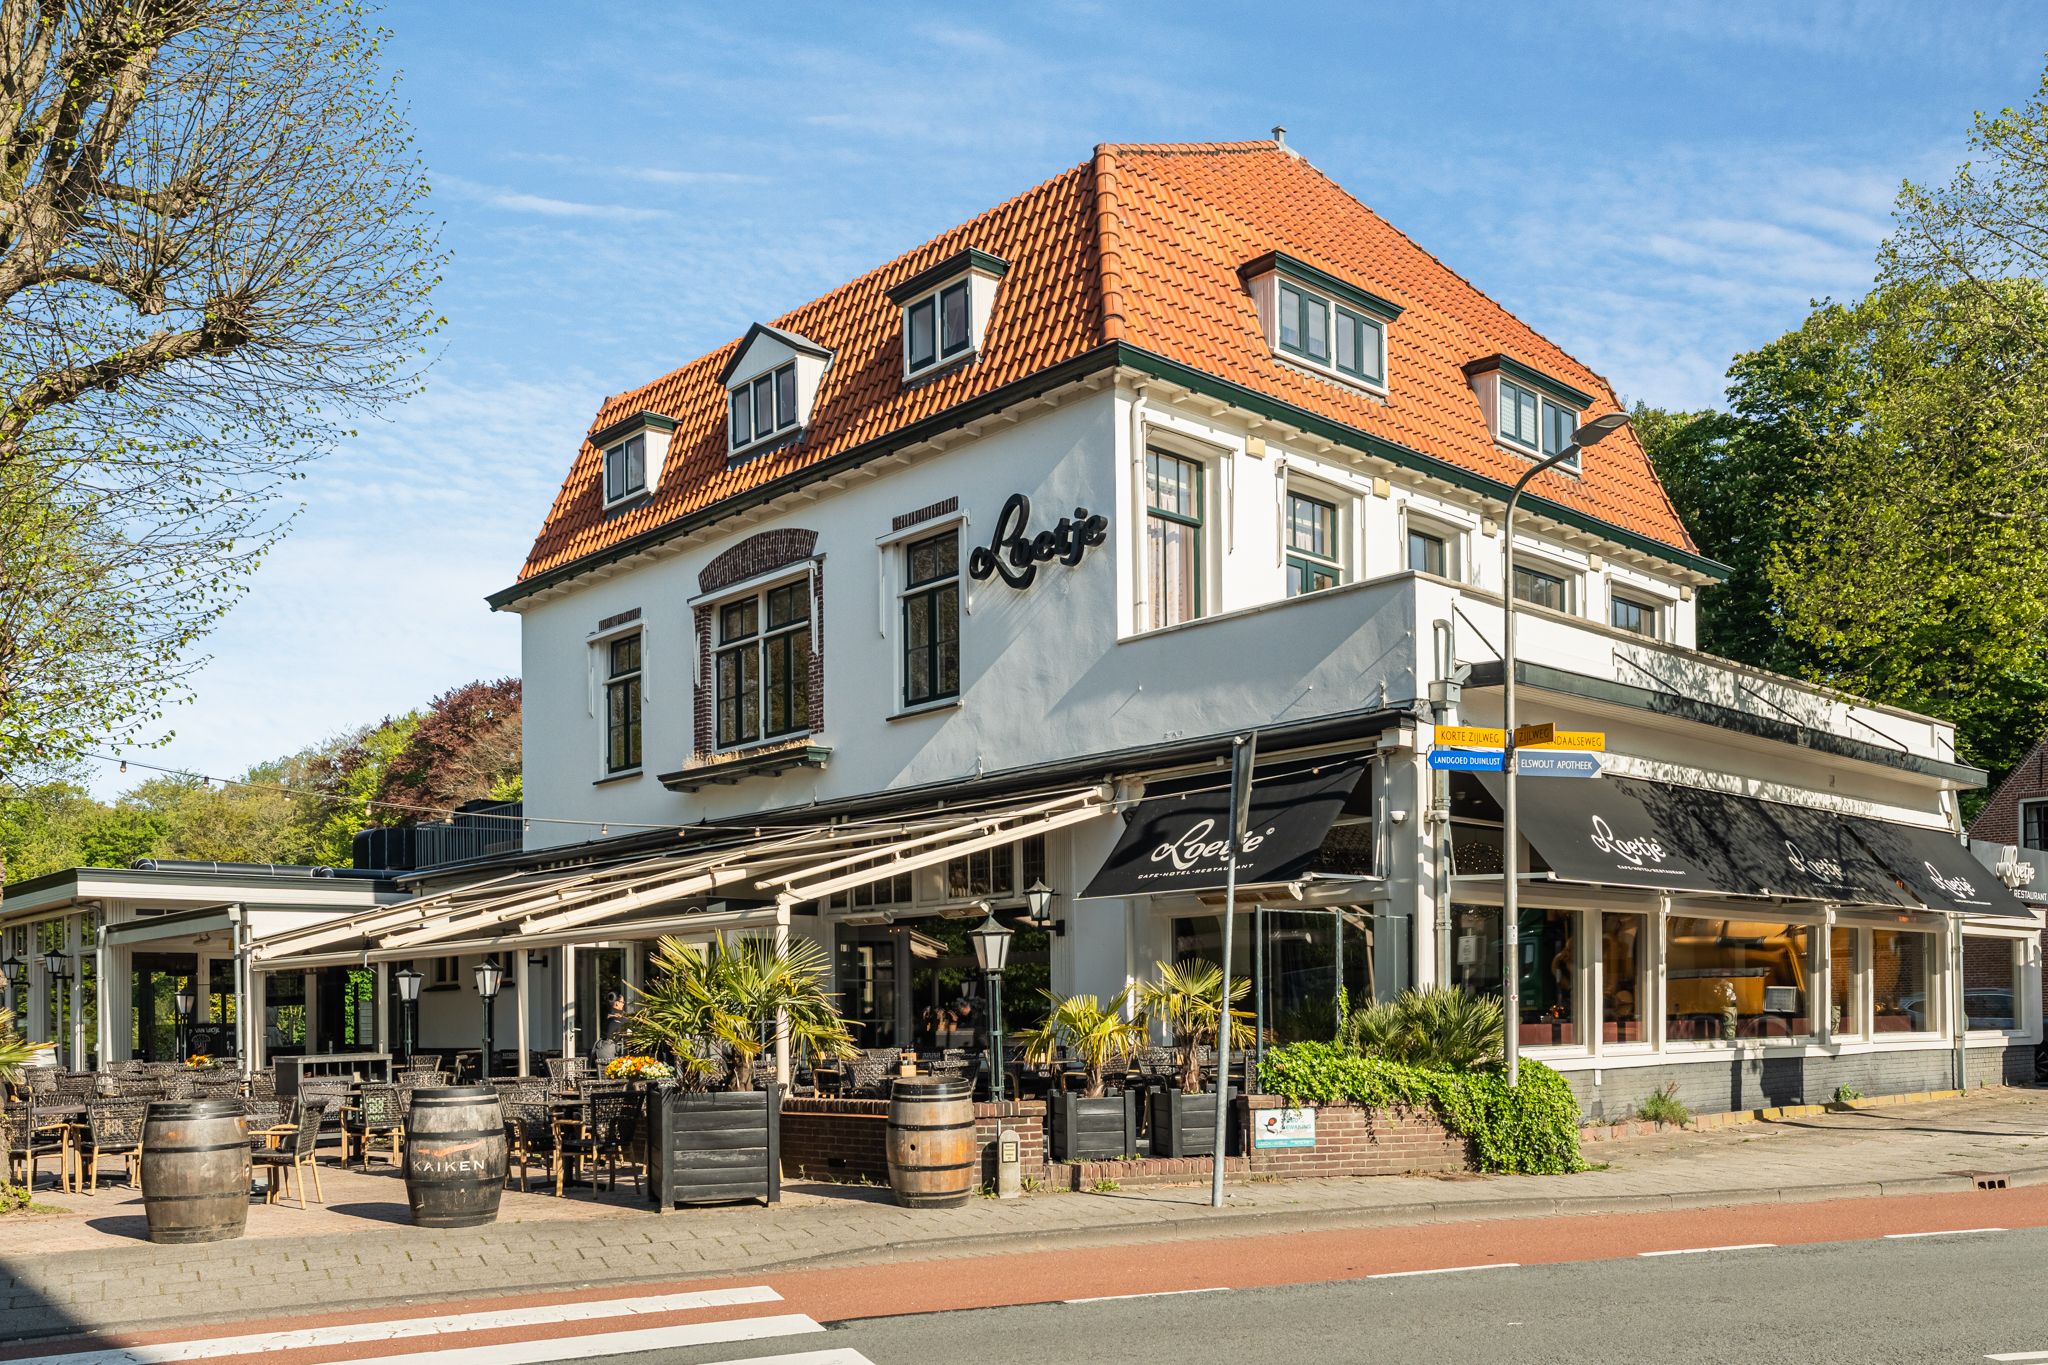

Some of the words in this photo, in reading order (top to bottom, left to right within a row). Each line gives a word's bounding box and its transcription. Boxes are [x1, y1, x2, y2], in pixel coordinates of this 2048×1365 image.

[969, 493, 1108, 590] Loetje
[1440, 731, 1466, 741] KORTE
[1468, 732, 1499, 743] ZIJLWEG
[1518, 727, 1550, 742] ZIJLWEG
[1434, 757, 1468, 765] LANDGOED
[1470, 757, 1500, 766] DUINLUST
[1521, 759, 1555, 769] ELSWOUT
[1557, 760, 1593, 770] APOTHEEK
[1591, 815, 1666, 865] Loetje
[1785, 840, 1846, 883] Loetje
[1996, 846, 2035, 888] Loetje
[2013, 889, 2047, 901] RESTAURANT
[413, 1160, 485, 1172] KAIKEN
